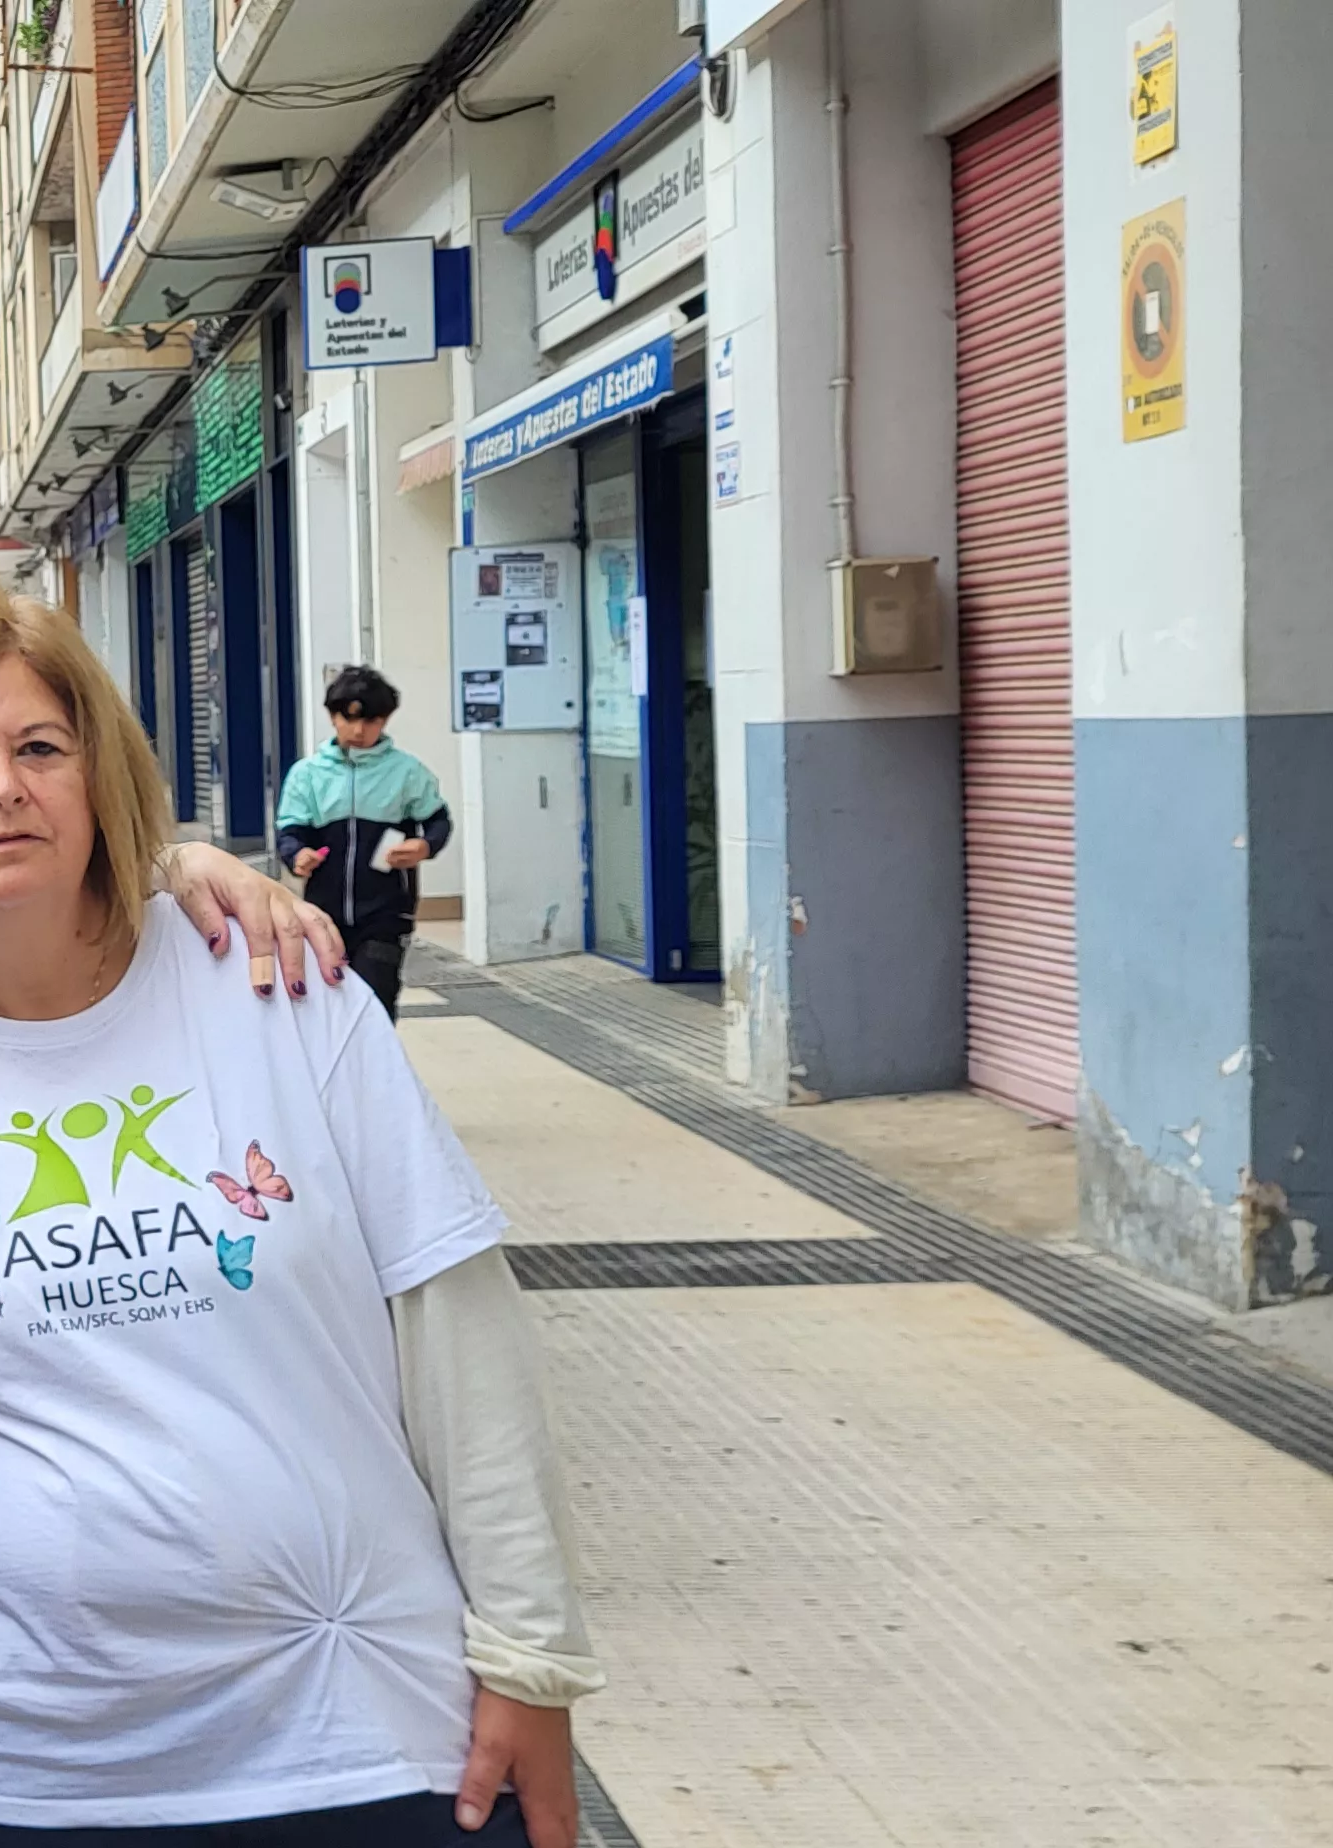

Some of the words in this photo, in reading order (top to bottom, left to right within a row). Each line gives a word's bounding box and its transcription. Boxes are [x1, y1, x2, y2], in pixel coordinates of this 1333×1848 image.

[621, 172, 680, 246] Apuestas
[683, 137, 705, 197] del
[326, 330, 384, 344] Apuestas
[387, 326, 407, 338] del
[379, 317, 387, 328] y
[326, 344, 369, 357] Estado
[523, 394, 579, 448] Apuestas
[581, 376, 603, 419] del
[604, 352, 658, 408] Estado
[3, 1202, 214, 1278] ASAFA
[42, 1266, 189, 1313] HUESCA
[27, 1320, 58, 1337] FM,
[60, 1311, 125, 1332] EM/SFC,
[128, 1304, 167, 1324] SQM
[171, 1306, 181, 1320] y
[184, 1297, 215, 1315] EHS
